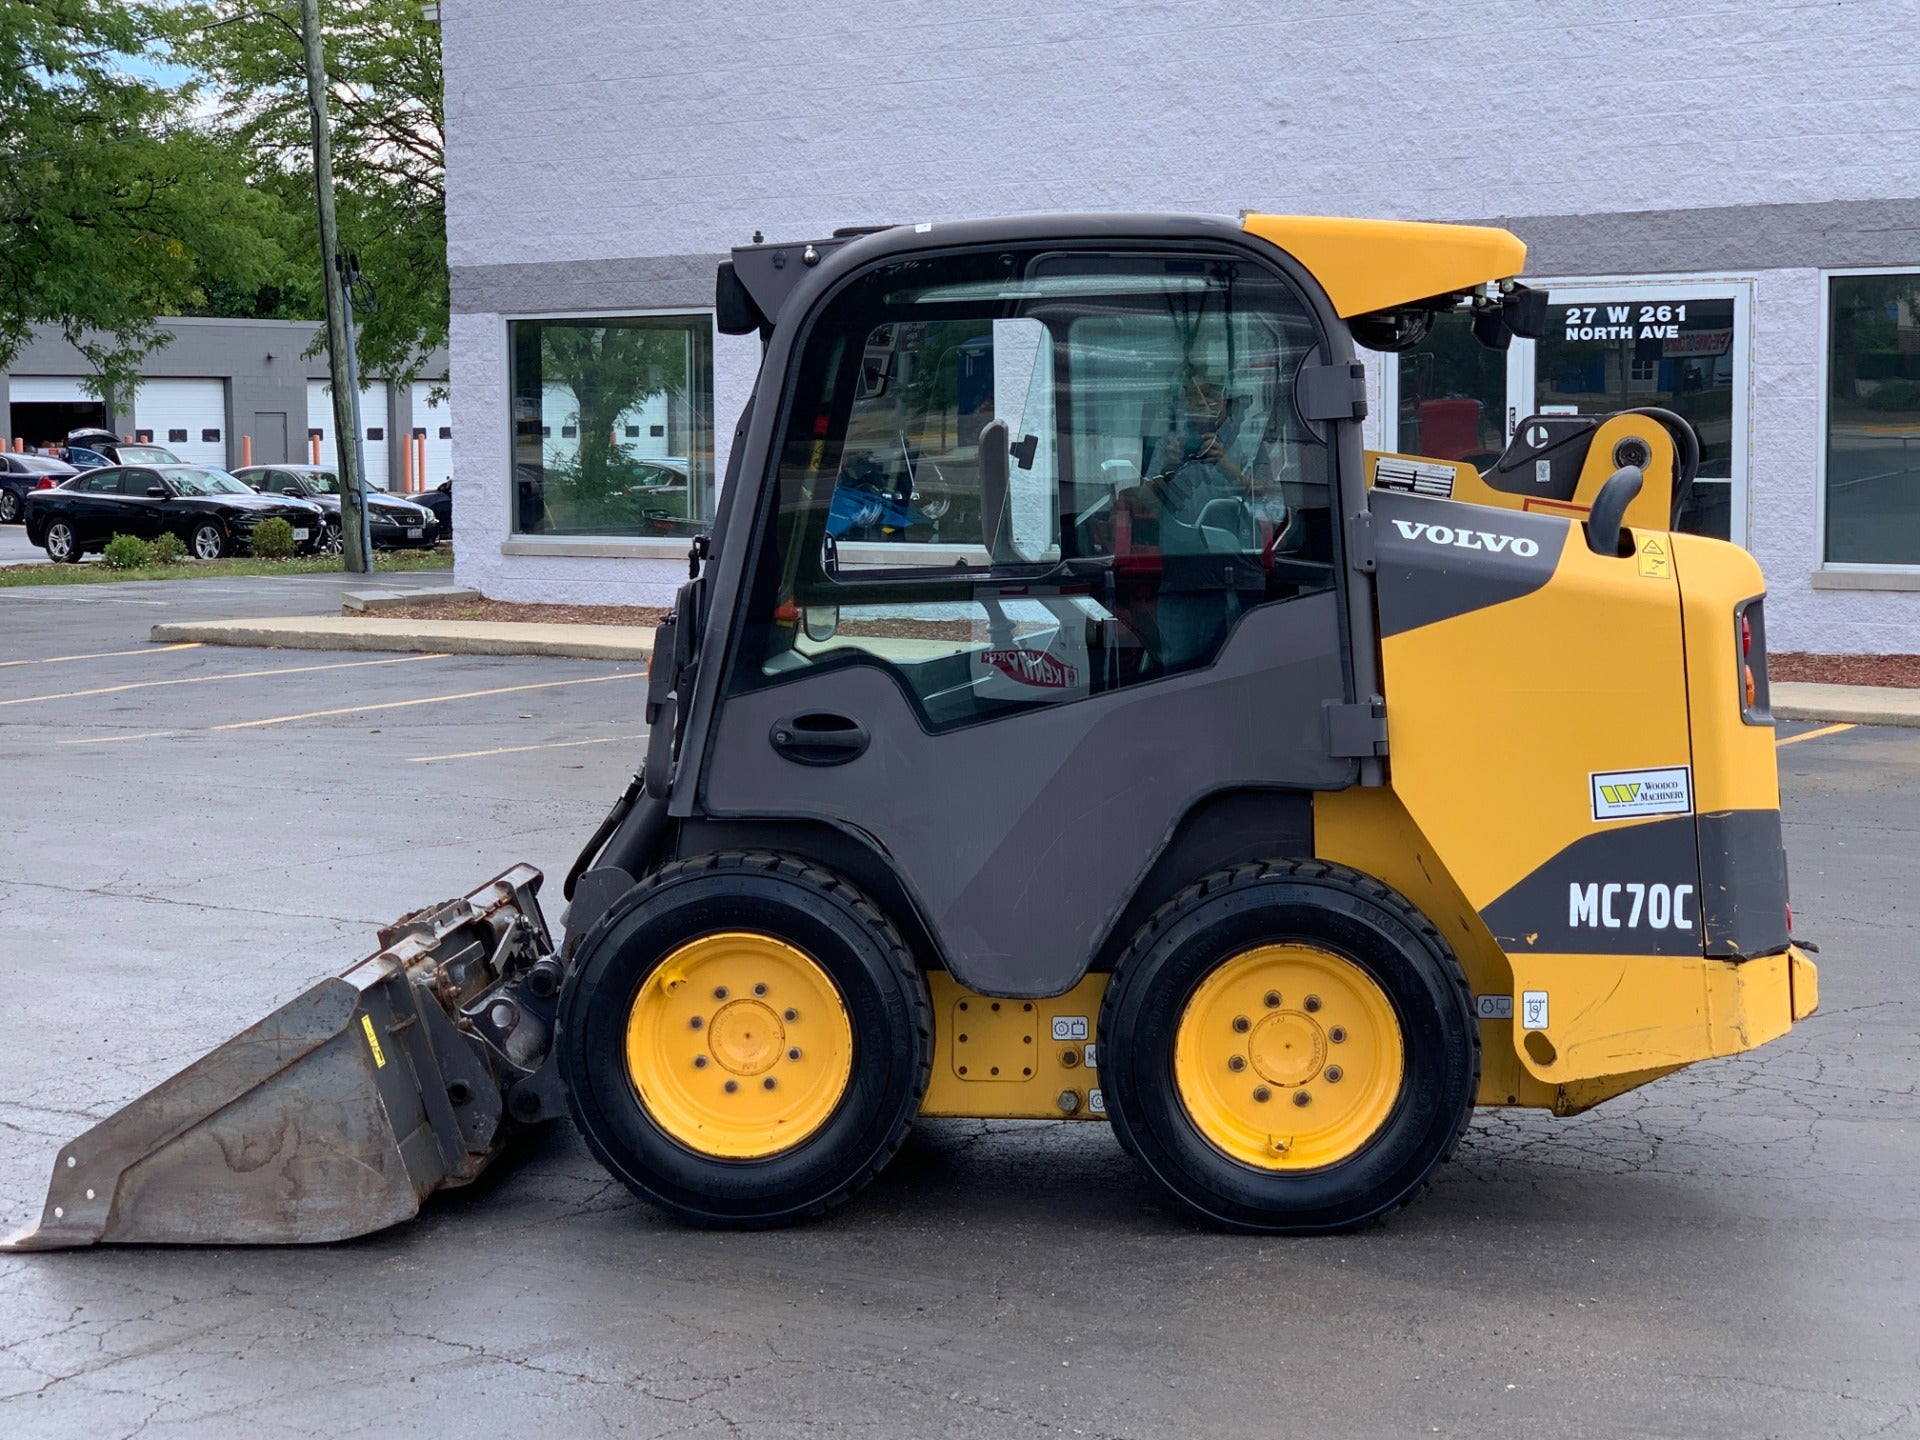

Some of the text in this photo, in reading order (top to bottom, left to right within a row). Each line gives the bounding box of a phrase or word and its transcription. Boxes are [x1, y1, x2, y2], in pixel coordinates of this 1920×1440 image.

[1565, 304, 1687, 325] 27 W 261
[1565, 325, 1679, 341] NORTH AVE
[1391, 519, 1540, 557] VOLVO
[1569, 882, 1694, 929] MC70C
